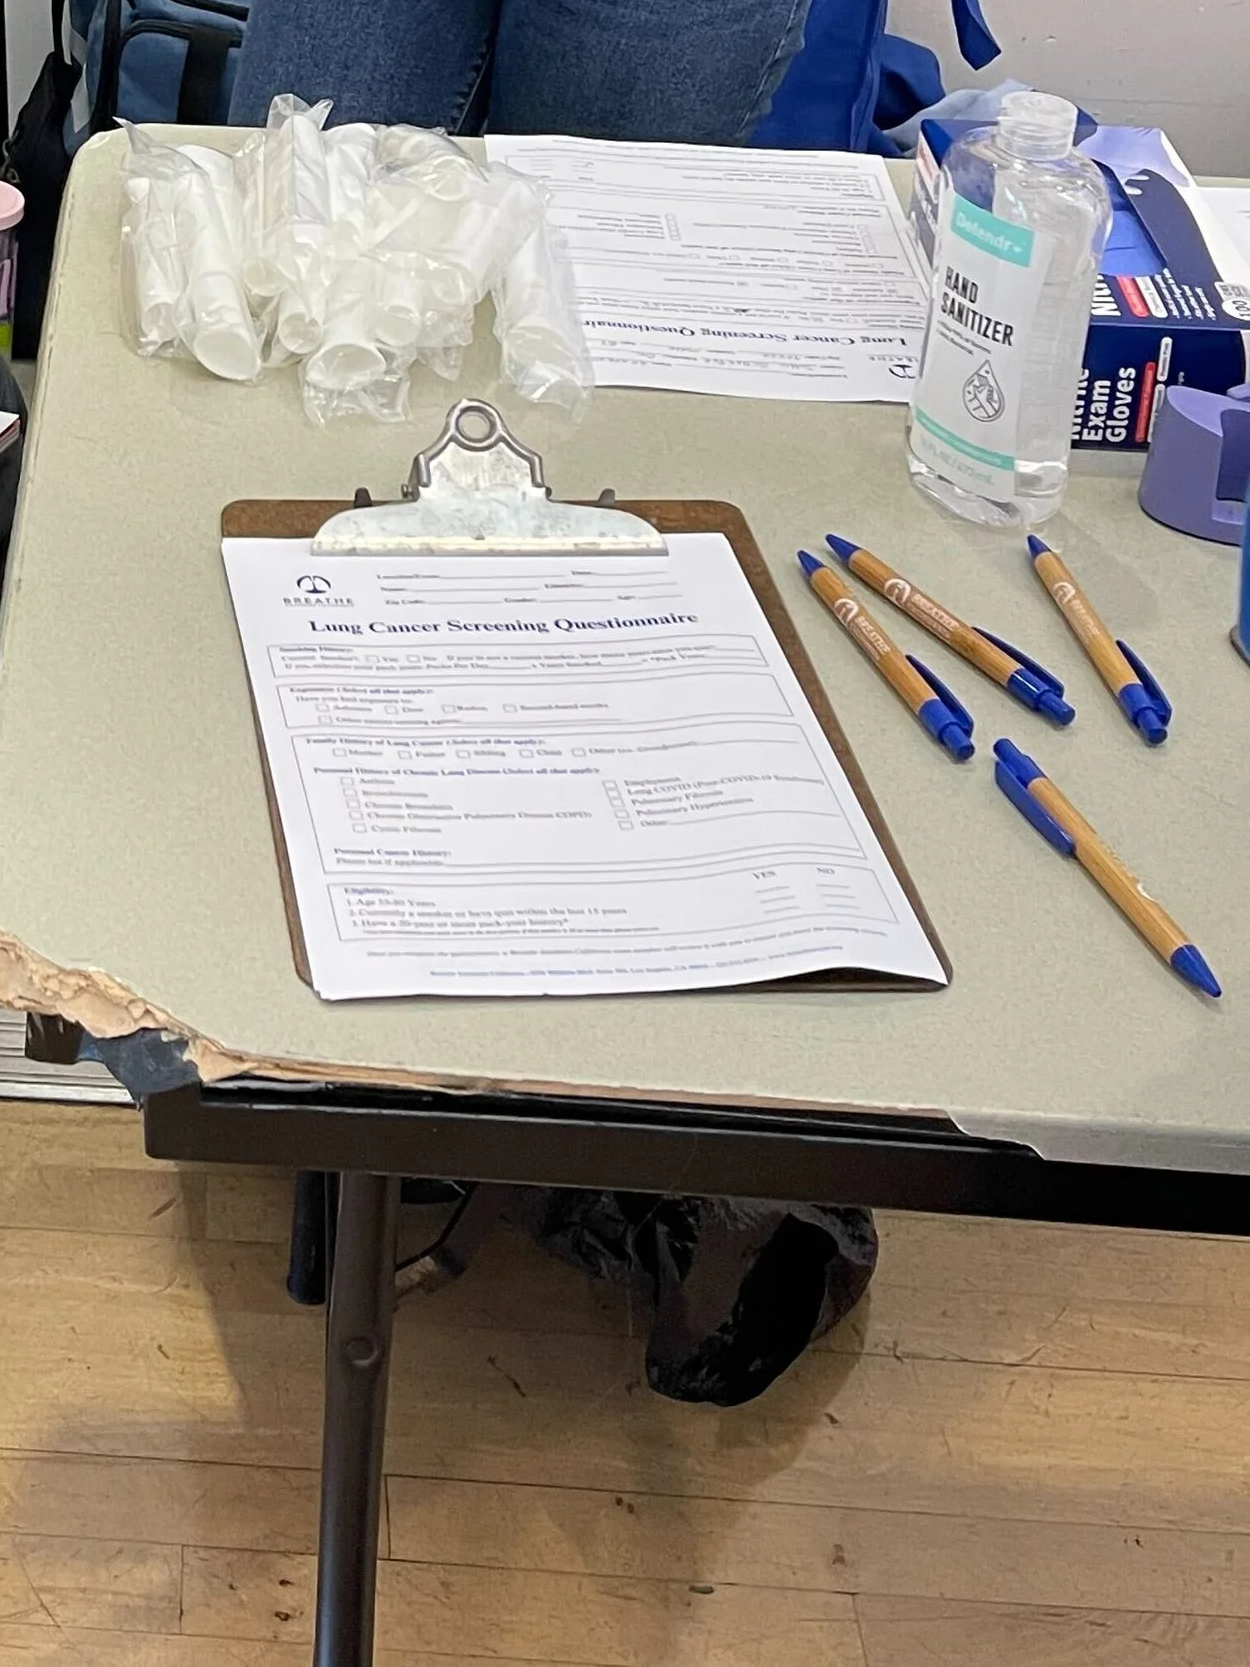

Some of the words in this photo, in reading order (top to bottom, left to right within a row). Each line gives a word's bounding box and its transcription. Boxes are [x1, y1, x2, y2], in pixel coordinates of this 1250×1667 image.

[945, 265, 979, 304] HAND
[583, 319, 695, 337] Questionnair
[940, 291, 1014, 347] SANITIZER
[700, 328, 787, 342] Screening
[793, 334, 855, 345] Cancer
[860, 336, 907, 346] Lung
[1082, 380, 1111, 441] Exam
[1105, 367, 1136, 443] Gloves
[283, 597, 354, 605] BREATHE
[309, 620, 364, 636] Lung
[369, 621, 441, 634] Cancer
[446, 618, 550, 634] Screening
[553, 612, 700, 633] Questionnaire
[752, 870, 777, 880] YES
[816, 867, 836, 875] NO
